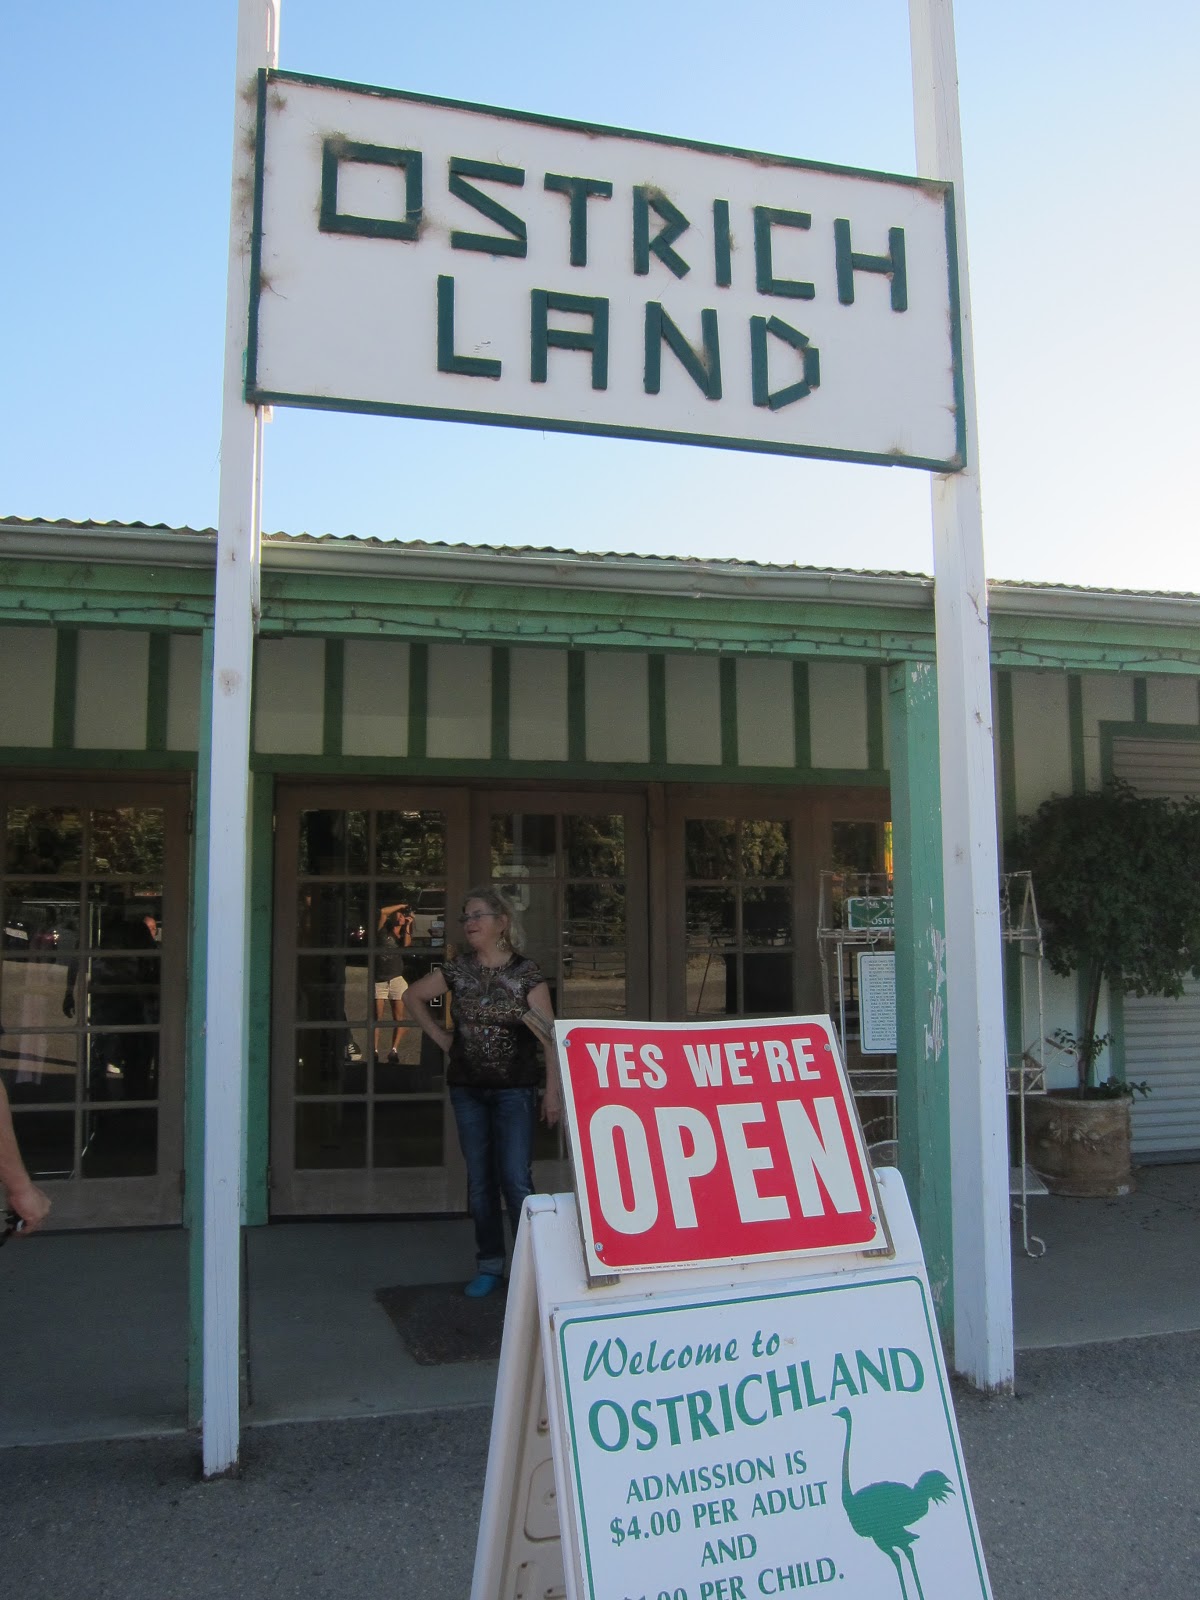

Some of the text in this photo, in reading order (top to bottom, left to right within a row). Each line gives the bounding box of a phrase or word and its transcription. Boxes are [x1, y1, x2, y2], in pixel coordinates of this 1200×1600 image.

[317, 137, 908, 313] OSTRICH
[436, 274, 821, 412] LAND
[585, 1037, 822, 1090] YES WE'RE
[589, 1096, 862, 1235] OPEN
[583, 1329, 781, 1382] Welcome to
[588, 1347, 925, 1453] OSTRICHLAND
[626, 1449, 807, 1505] ADMISSION IS
[609, 1480, 828, 1547] $4.00 PER ADULT
[699, 1575, 747, 1600] PER
[757, 1557, 845, 1596] CHILD.
[700, 1533, 758, 1568] AND
